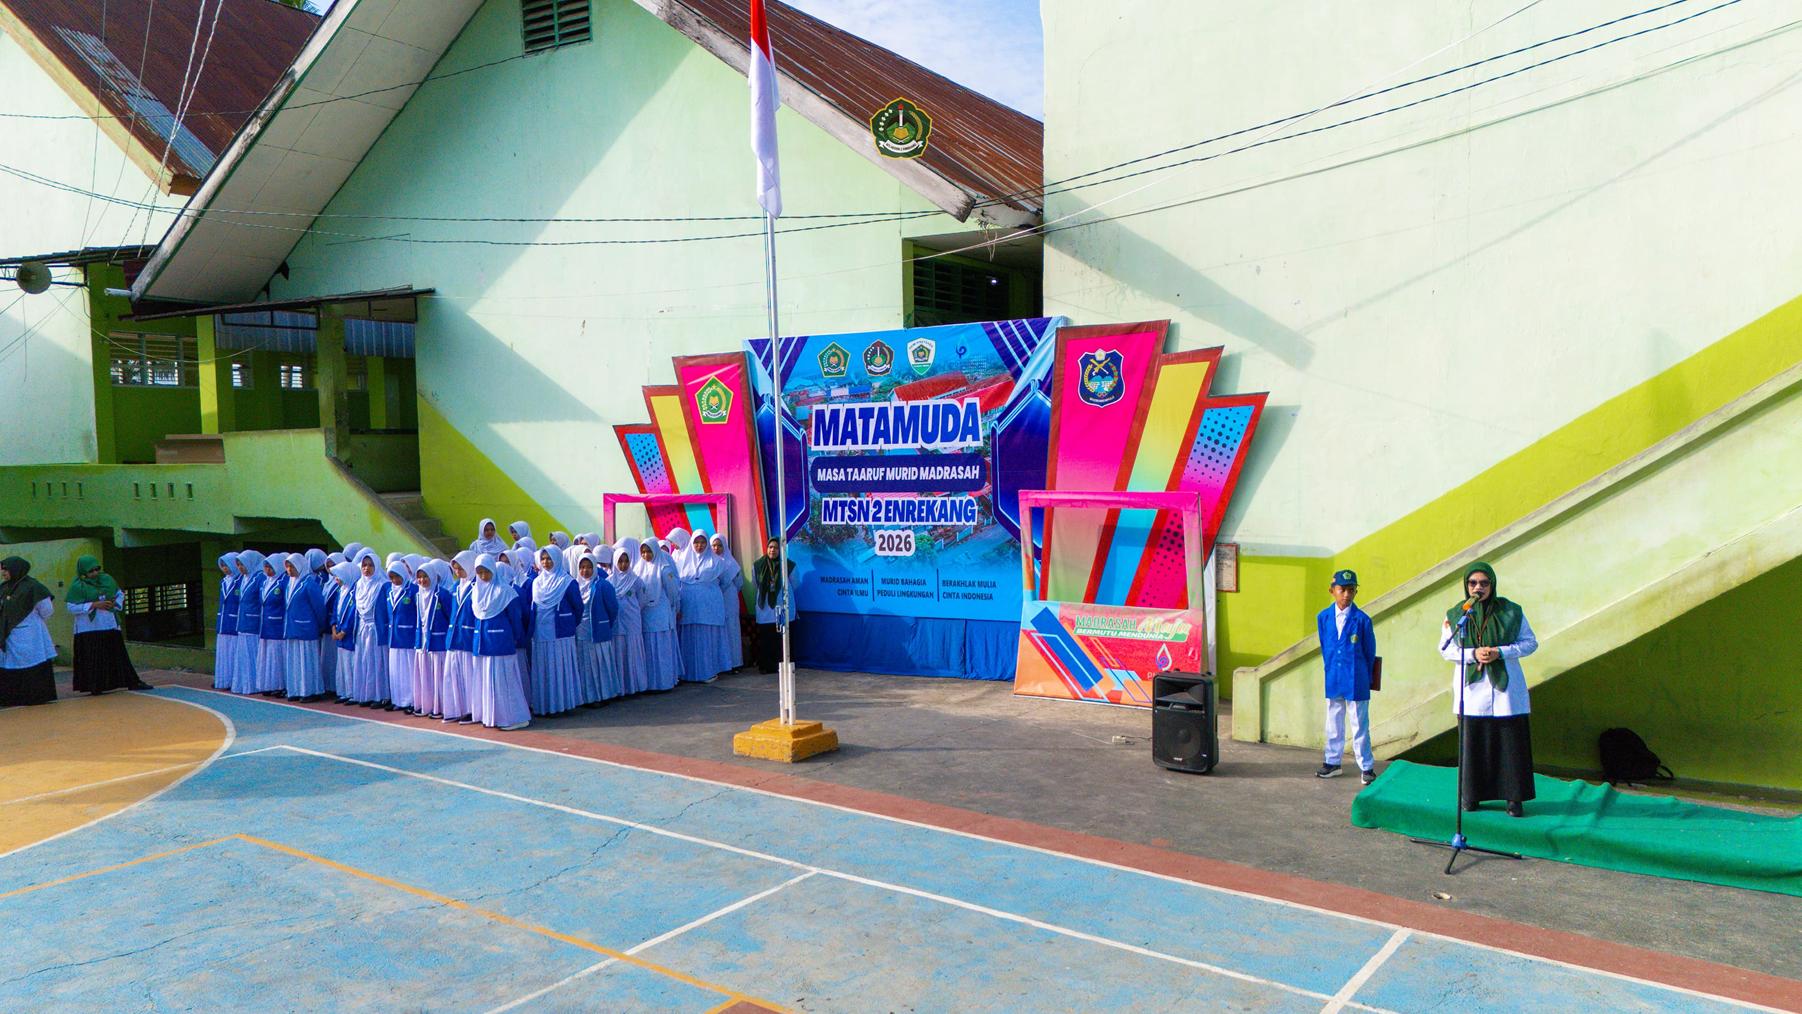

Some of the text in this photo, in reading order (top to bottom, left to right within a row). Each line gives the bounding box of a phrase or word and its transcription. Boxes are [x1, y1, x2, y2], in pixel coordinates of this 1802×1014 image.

[813, 402, 981, 446] MATAMUDA
[817, 465, 979, 481] MASA TAARUF MURID MADRASAH
[823, 499, 977, 523] MTSN 2 ENREKANG
[878, 534, 912, 552] 2026
[820, 576, 869, 585] MADRASAH AMAN
[901, 578, 927, 586] BAHAGIA
[942, 580, 997, 588] BERAKHLAK MULIA
[837, 588, 854, 596] CINTA
[877, 589, 934, 599] PEDULI LINGKUNGAN
[942, 592, 994, 601] CINTA INDONESIA
[1076, 615, 1137, 629] MADRASAH
[1076, 628, 1165, 640] BERMUTU MENDUNIA
